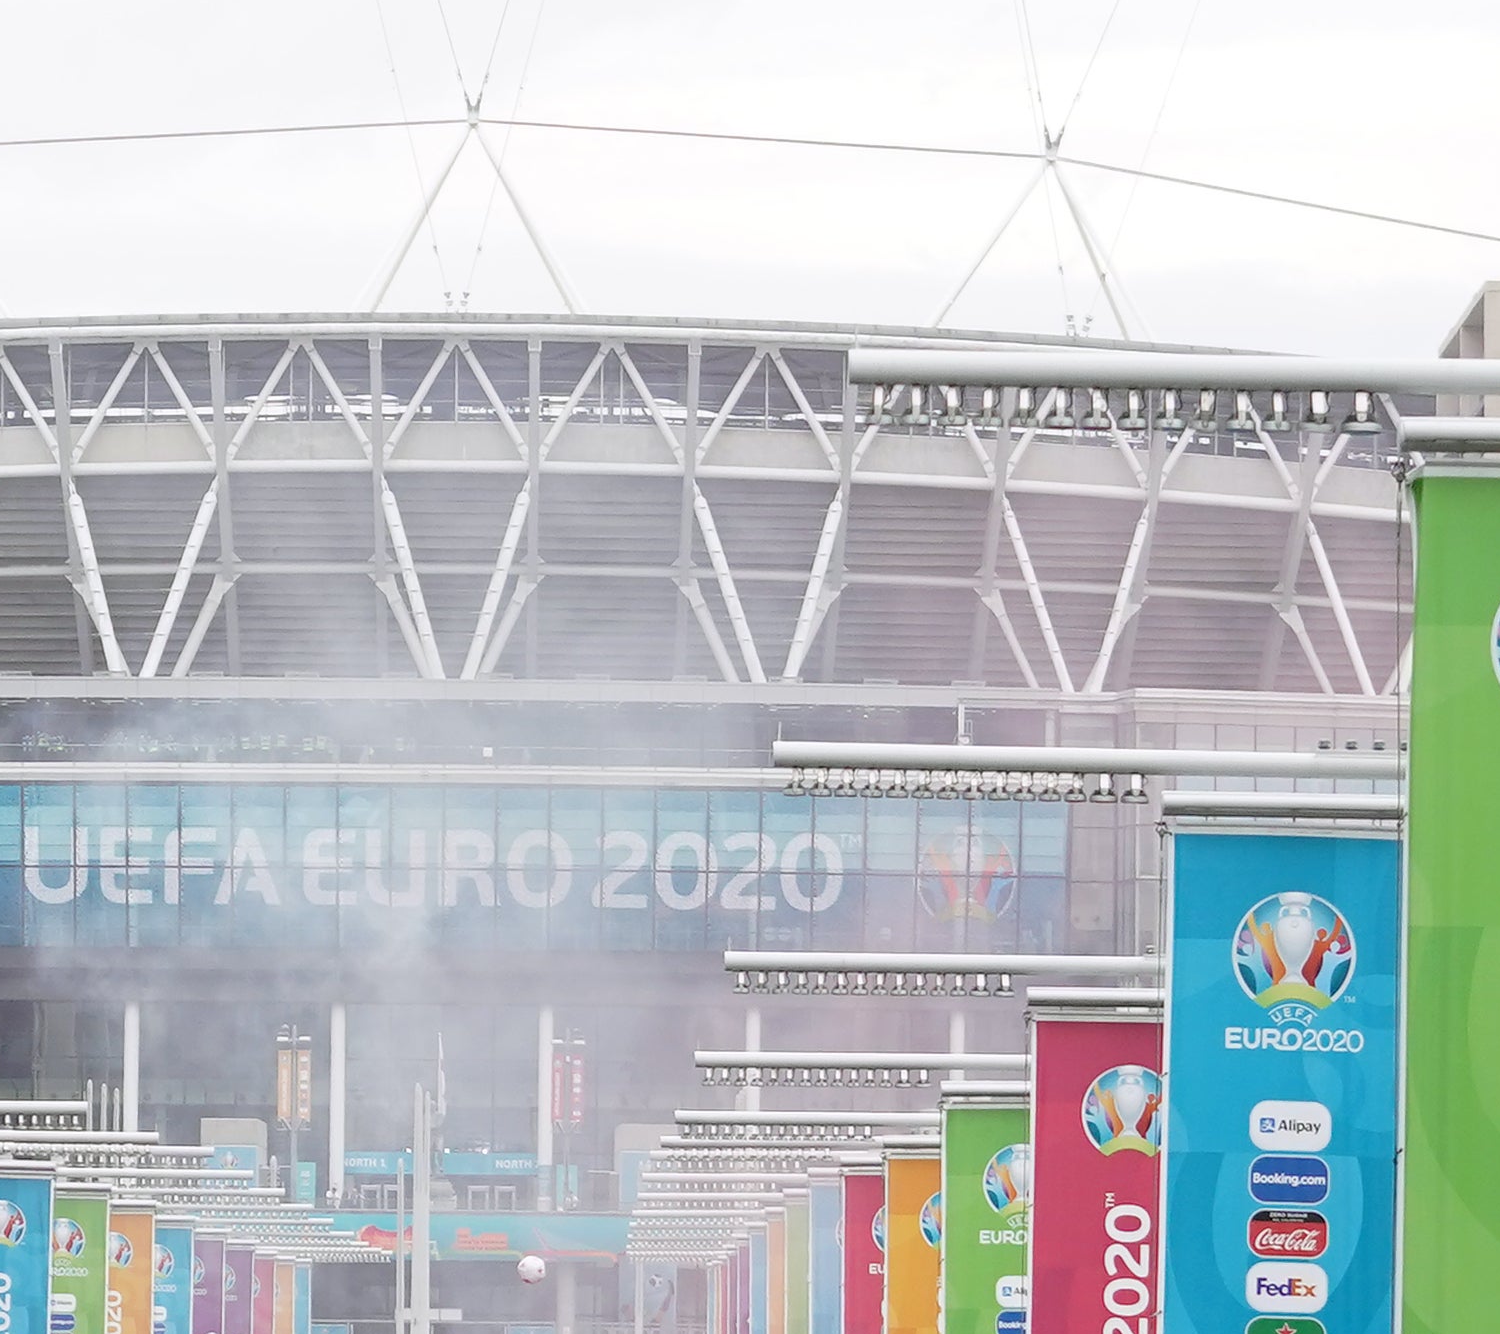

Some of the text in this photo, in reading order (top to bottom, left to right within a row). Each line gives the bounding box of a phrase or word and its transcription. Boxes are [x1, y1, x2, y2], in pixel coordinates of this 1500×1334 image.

[23, 823, 281, 906] UEFA
[303, 829, 571, 911] EURO
[1271, 1009, 1313, 1024] UEFA
[1224, 1027, 1364, 1053] EURO2020
[1278, 1118, 1321, 1135] Alipay
[344, 1158, 378, 1168] NORTH
[495, 1159, 532, 1169] NORTH
[1252, 1171, 1326, 1188] Booking.com
[979, 1230, 1027, 1245] EURO
[1255, 1227, 1320, 1252] Coca-Cola
[1256, 1277, 1316, 1298] FedEx
